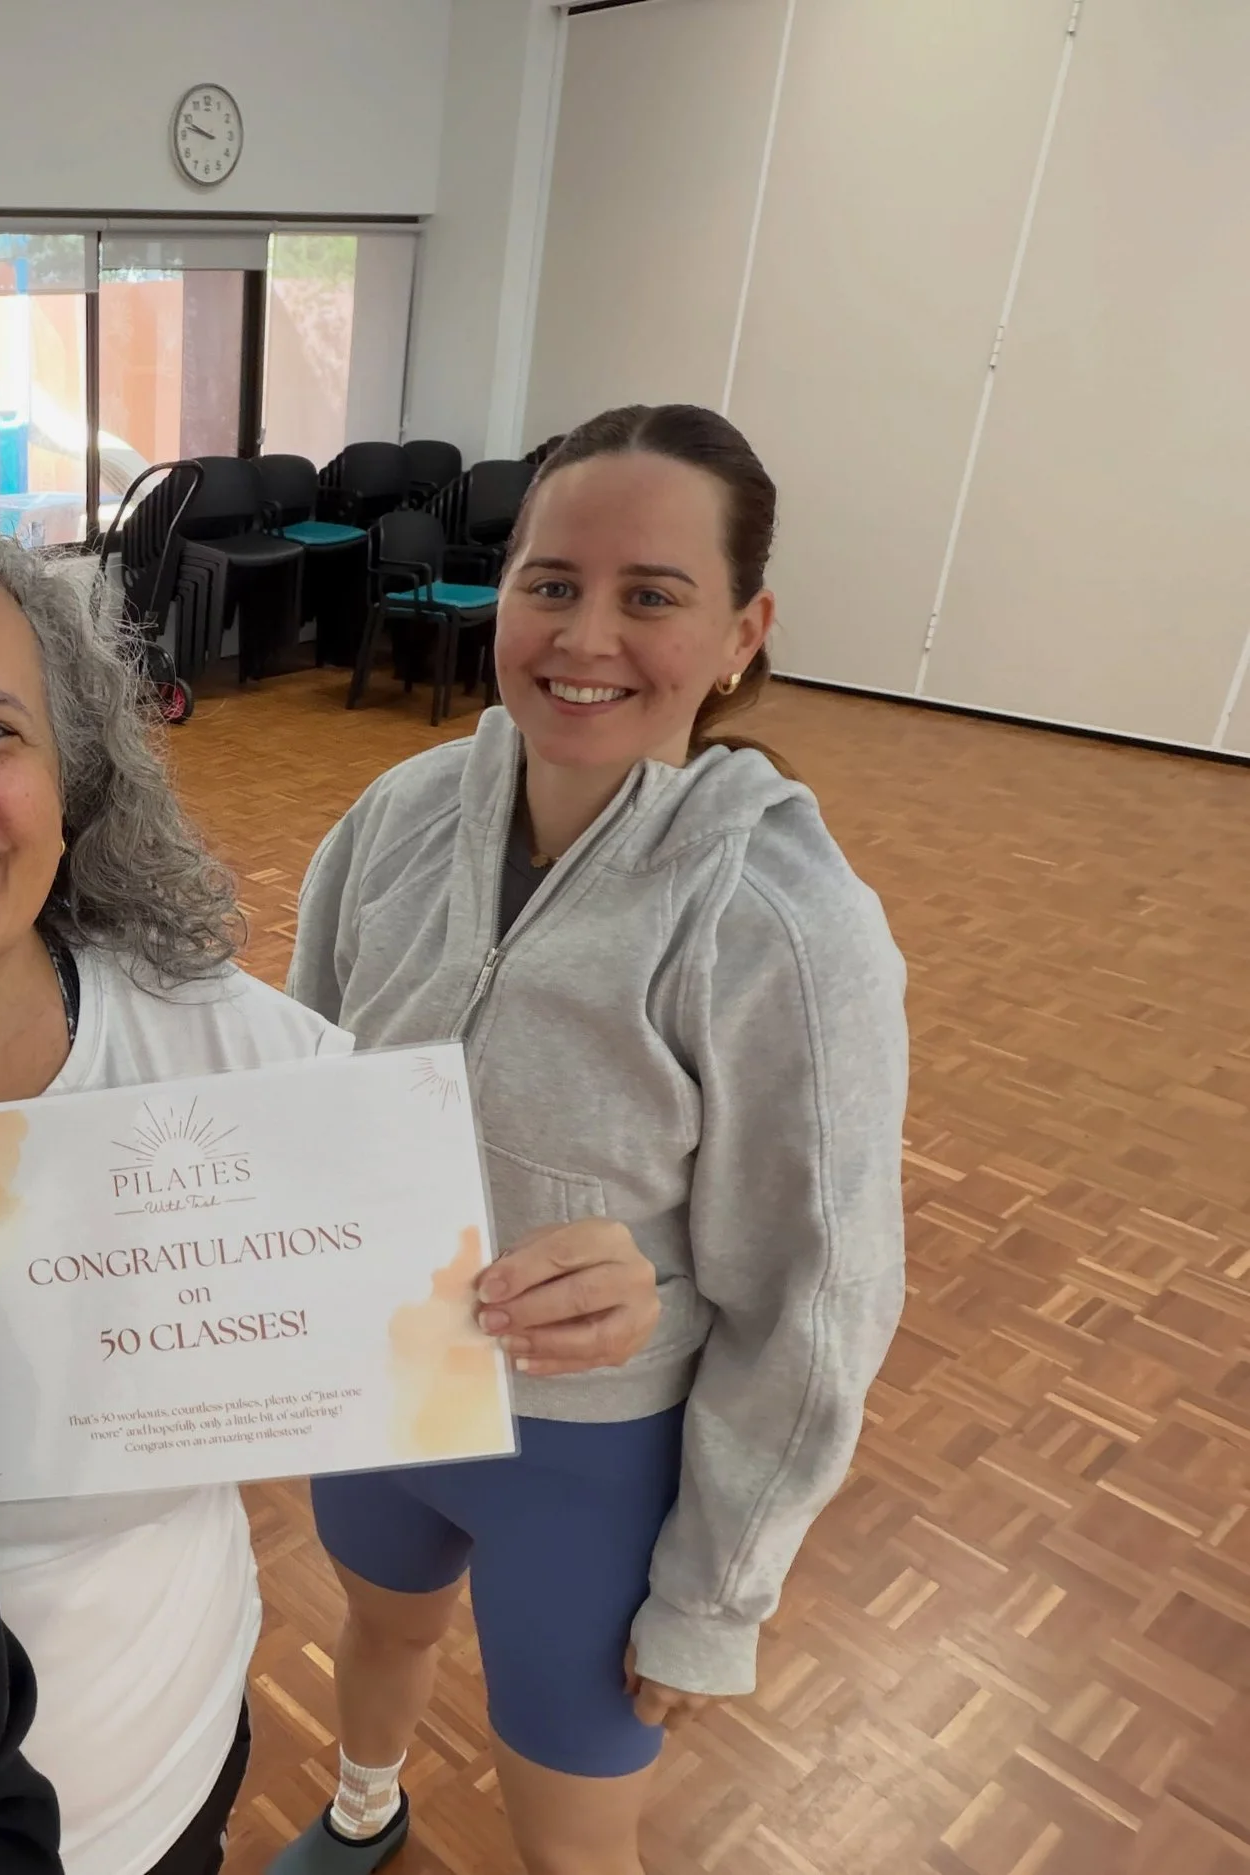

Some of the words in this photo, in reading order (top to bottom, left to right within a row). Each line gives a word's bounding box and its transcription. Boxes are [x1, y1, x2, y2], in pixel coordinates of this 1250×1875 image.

[113, 1159, 251, 1197] PILATES
[144, 1200, 185, 1214] With
[28, 1222, 362, 1286] CONGRATULATIONS
[178, 1287, 211, 1305] on
[100, 1328, 141, 1362] 50
[150, 1310, 308, 1351] CLASSES!
[69, 1413, 100, 1427] That's
[100, 1412, 115, 1424] 50
[171, 1401, 224, 1417] countless
[264, 1394, 298, 1409] plenty
[301, 1389, 313, 1402] of
[341, 1387, 362, 1398] one
[126, 1423, 147, 1437] and
[147, 1419, 197, 1437] hopefully
[199, 1416, 222, 1430] only
[225, 1417, 232, 1426] a
[233, 1412, 258, 1426] little
[259, 1411, 274, 1423] bit
[276, 1408, 289, 1420] of
[290, 1403, 343, 1419] suffering!
[124, 1439, 176, 1454] Congrats
[176, 1438, 190, 1448] on
[192, 1437, 207, 1447] an
[209, 1430, 255, 1444] amazing
[255, 1424, 312, 1440] milestone!
